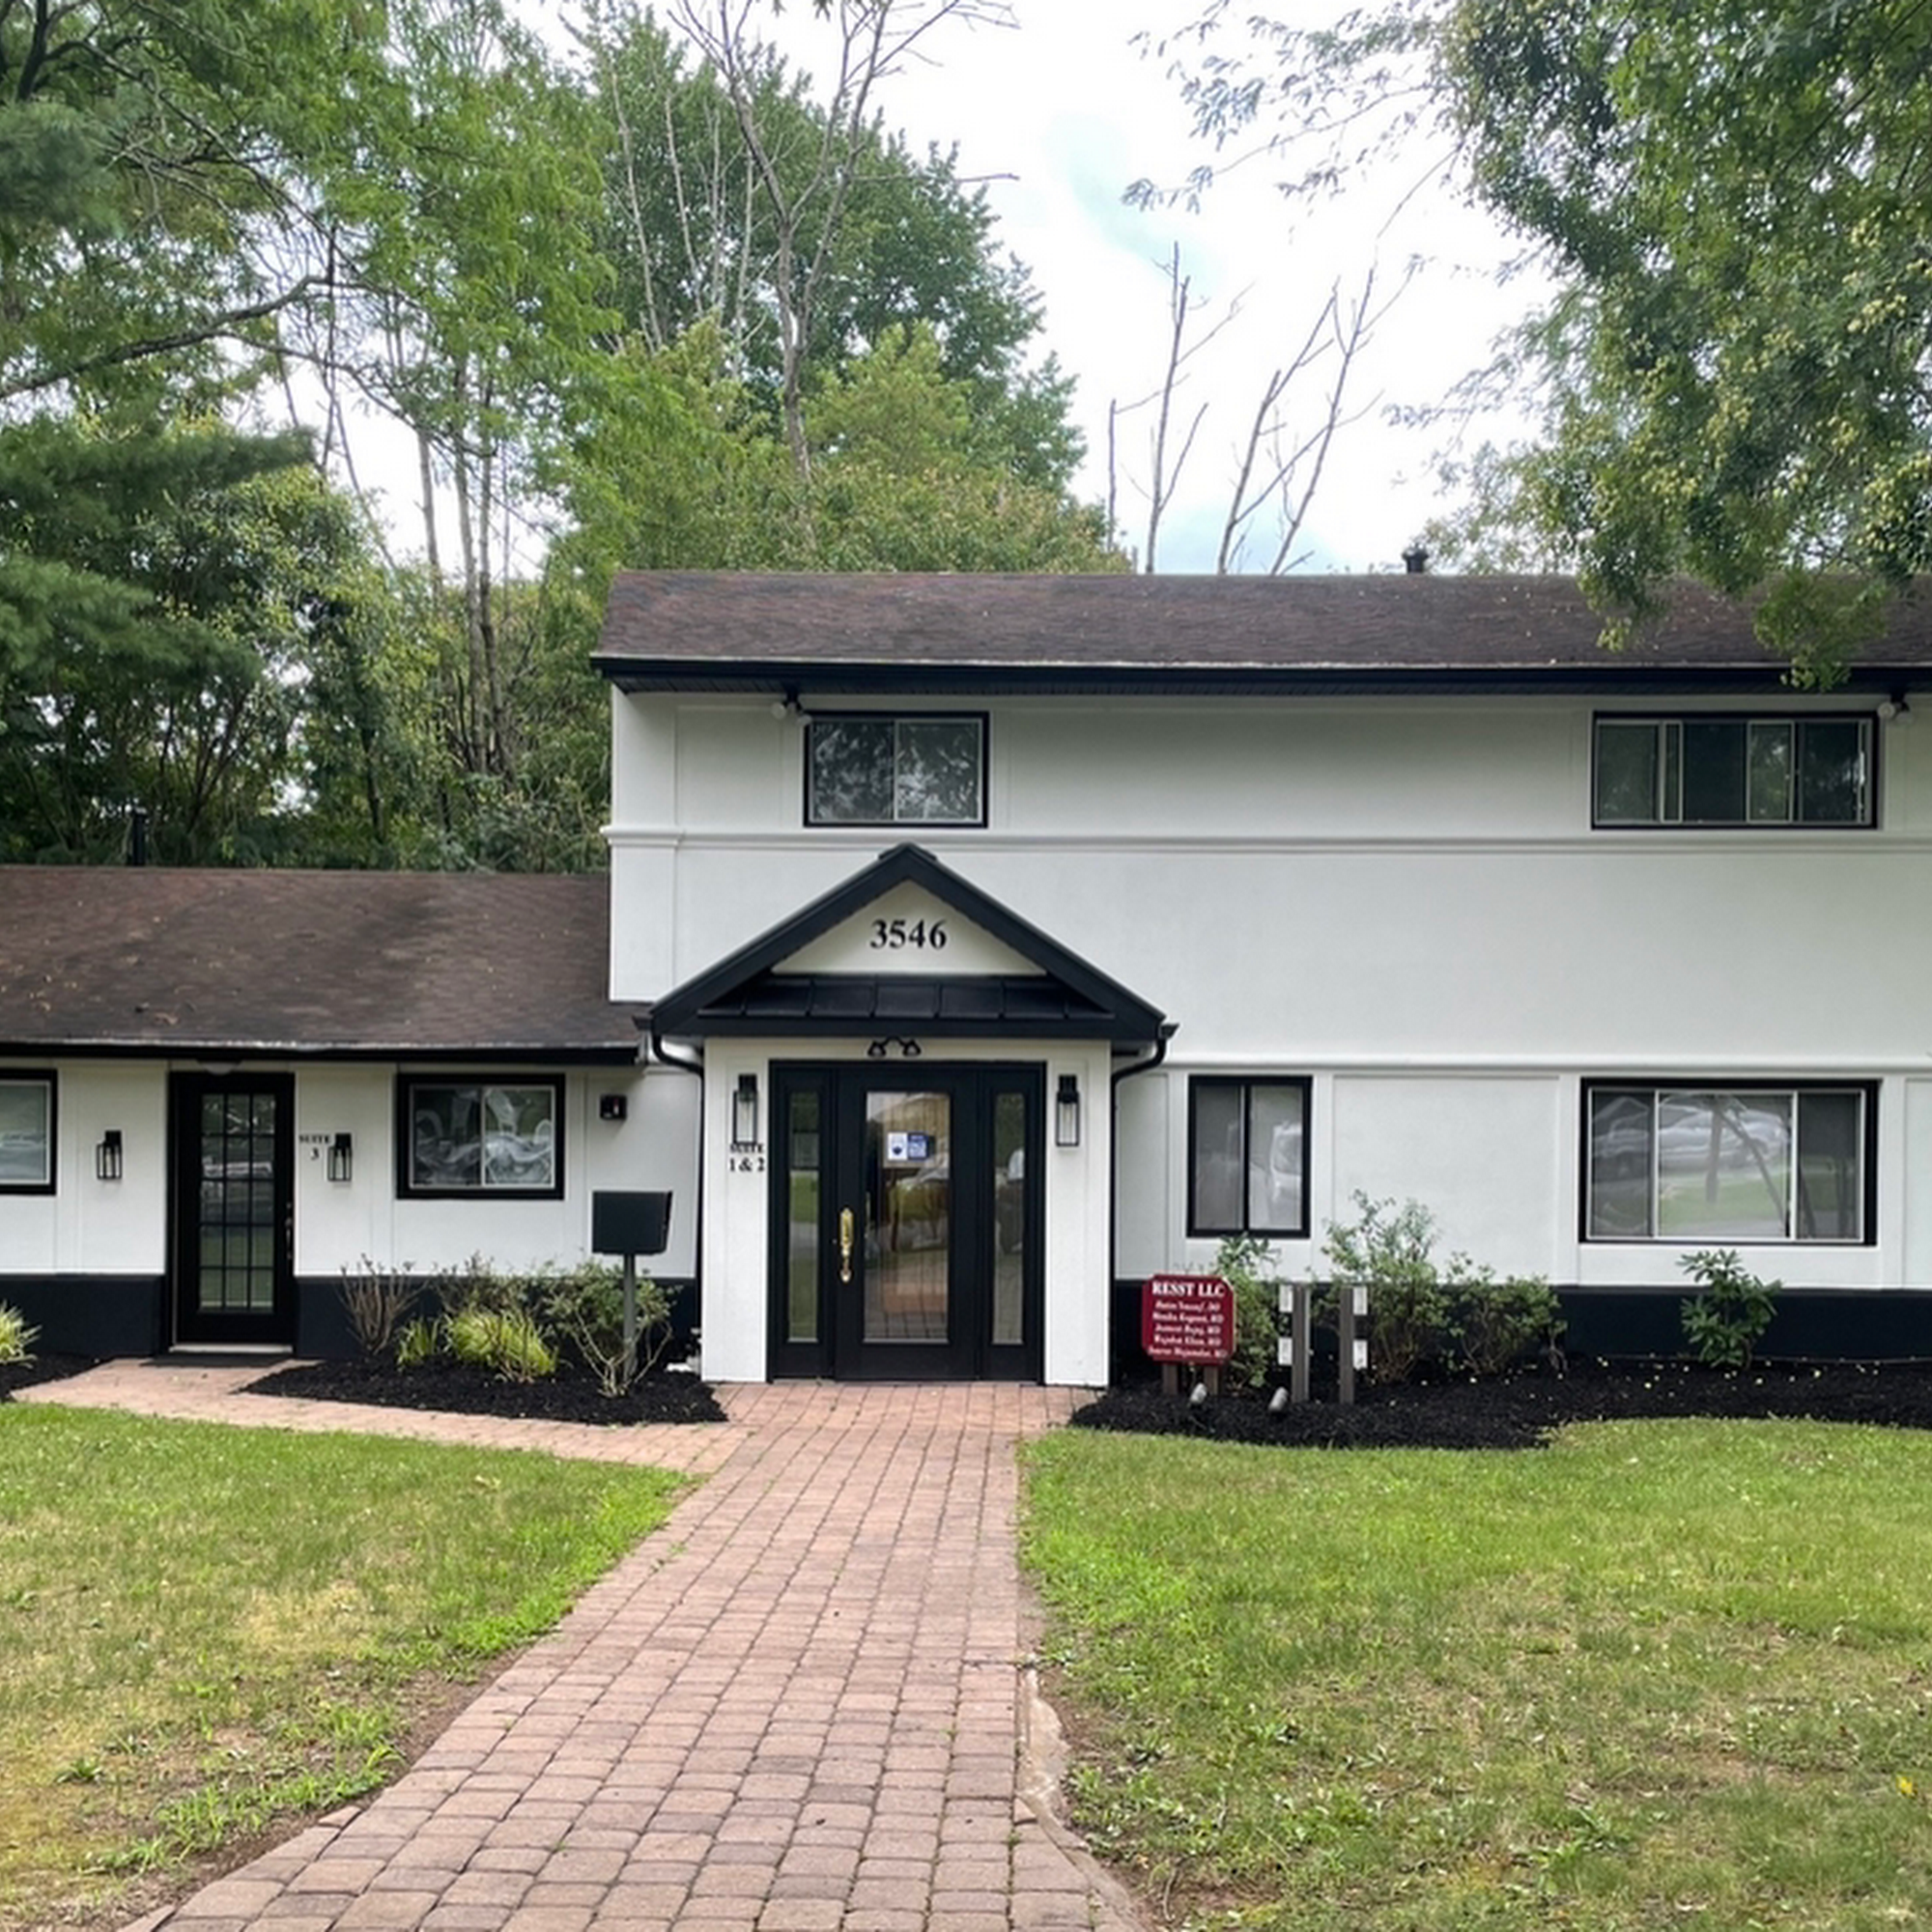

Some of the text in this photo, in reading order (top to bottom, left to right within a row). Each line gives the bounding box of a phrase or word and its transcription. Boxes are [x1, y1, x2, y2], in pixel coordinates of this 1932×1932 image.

[869, 919, 947, 951] 3546
[310, 1147, 320, 1161] 3
[729, 1157, 765, 1172] 1 & 2
[1198, 1283, 1225, 1297] LLC
